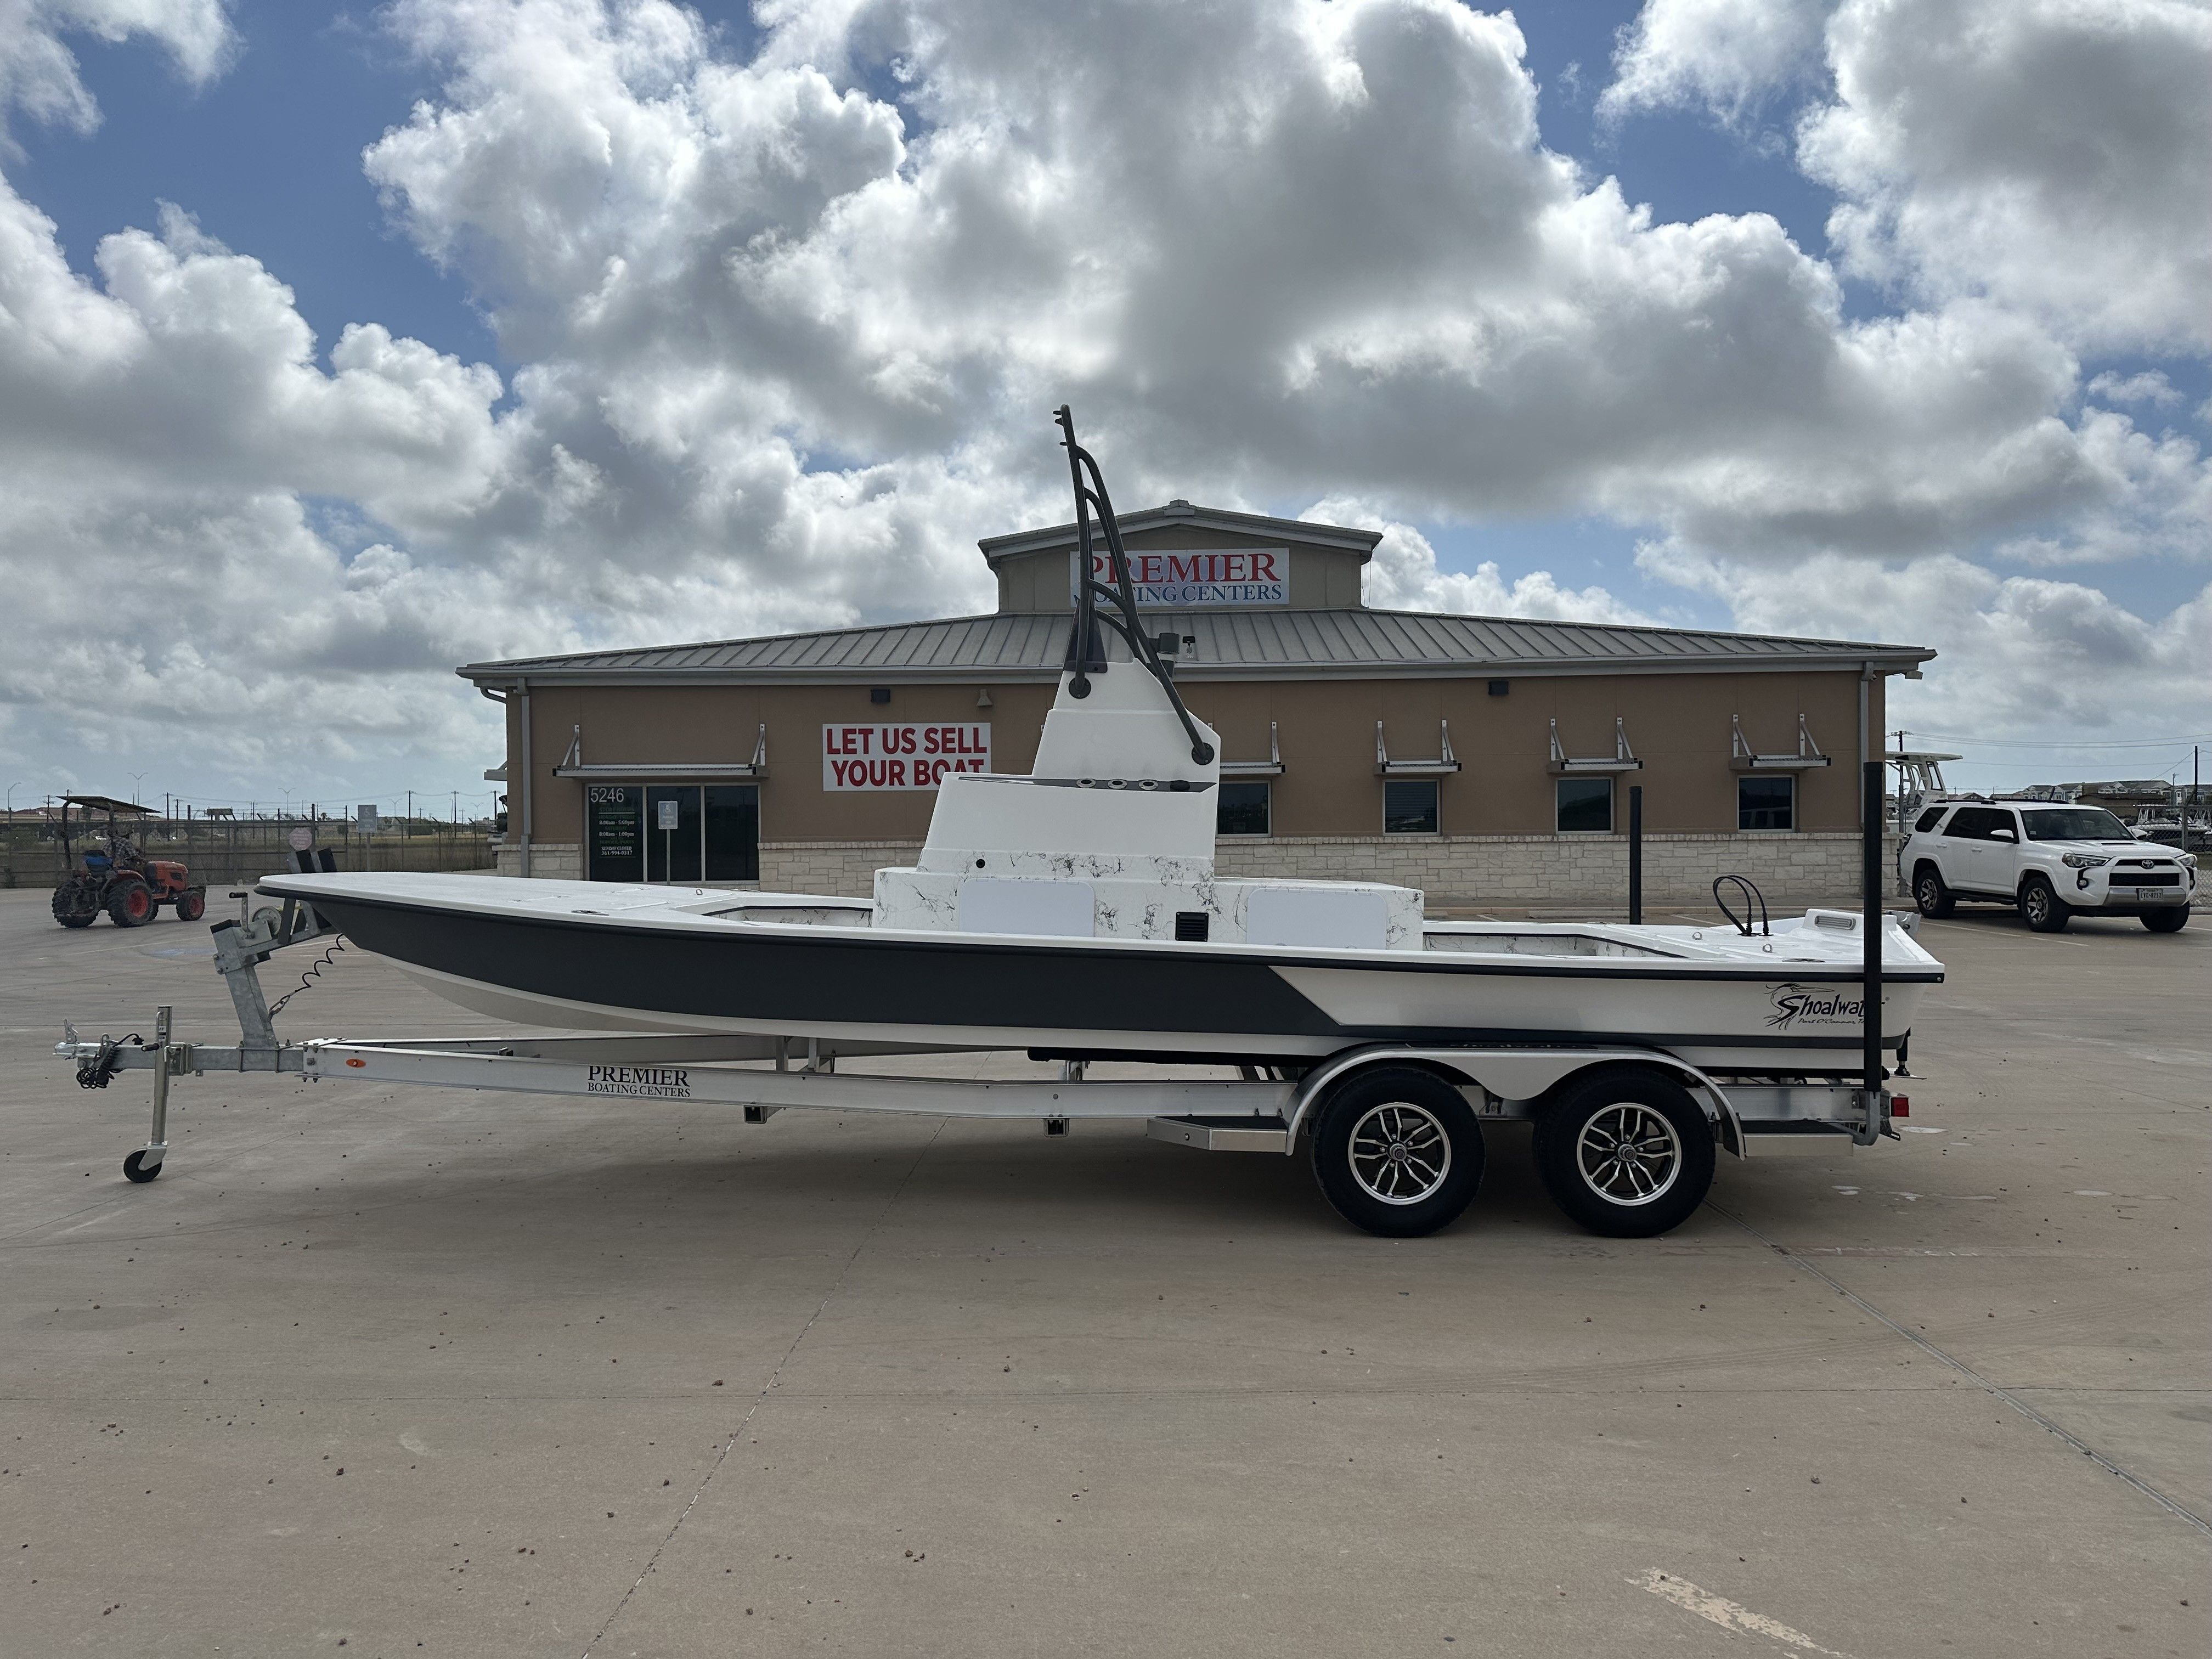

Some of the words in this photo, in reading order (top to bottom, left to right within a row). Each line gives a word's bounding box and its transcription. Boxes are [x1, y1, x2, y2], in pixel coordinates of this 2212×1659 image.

[1182, 584, 1282, 602] CENTERS
[827, 728, 874, 754] LET
[882, 727, 917, 754] US
[924, 727, 987, 754] SELL
[831, 760, 906, 787] YOUR
[590, 788, 624, 803] 5246
[1765, 994, 1886, 1028] Shoalwat
[588, 1065, 690, 1087] PREMIER
[588, 1082, 637, 1094] BOATING
[639, 1085, 690, 1097] CENTERS
